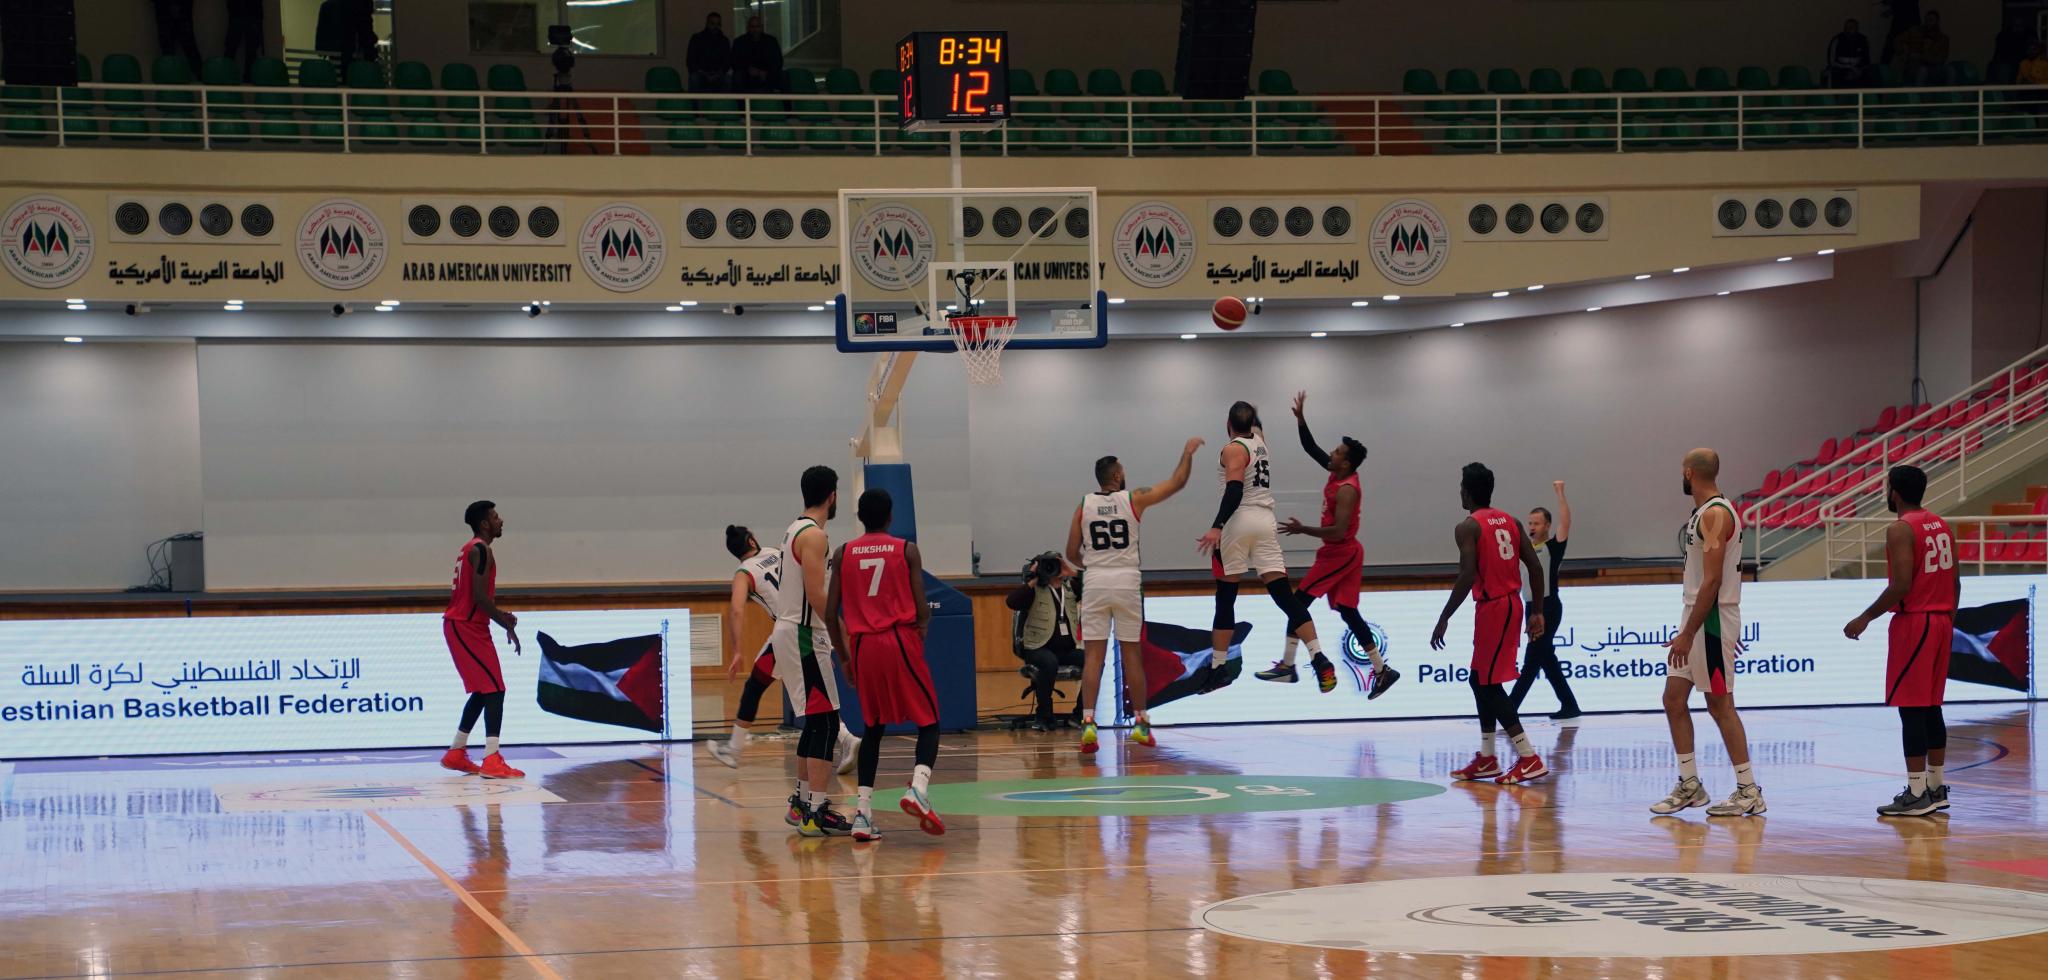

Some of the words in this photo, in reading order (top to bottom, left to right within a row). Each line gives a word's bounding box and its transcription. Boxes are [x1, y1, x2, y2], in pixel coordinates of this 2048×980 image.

[939, 38, 1001, 65] 8:34
[952, 71, 989, 113] 12
[109, 254, 176, 285] الأمريكية
[180, 260, 228, 286] العربية
[232, 260, 284, 285] الجامعة
[403, 262, 435, 282] ARAB
[438, 262, 499, 282] AMERICAN
[502, 263, 572, 283] UNIVERSITY
[681, 258, 741, 287] الأمريكية
[746, 263, 790, 286] العربية
[1206, 255, 1266, 284] الأمريكية
[1270, 260, 1312, 284] العربية
[1315, 259, 1359, 283] الجامعة
[1089, 518, 1129, 551] 69
[1495, 528, 1515, 561] 8
[851, 544, 895, 555] RUKSHAN
[1924, 532, 1954, 574] 28
[859, 557, 886, 597] 7
[21, 663, 80, 686] السلة
[89, 662, 143, 691] لكرة
[151, 659, 281, 695] الفلسطيني
[123, 694, 269, 719] Basketball
[279, 692, 424, 715] Federation
[1527, 890, 1680, 909] CUP
[1611, 876, 1847, 917] QUALIFIERS
[1468, 905, 1600, 924] FIBA
[1601, 908, 1787, 933] ASIA
[1785, 915, 1948, 939] 2021
